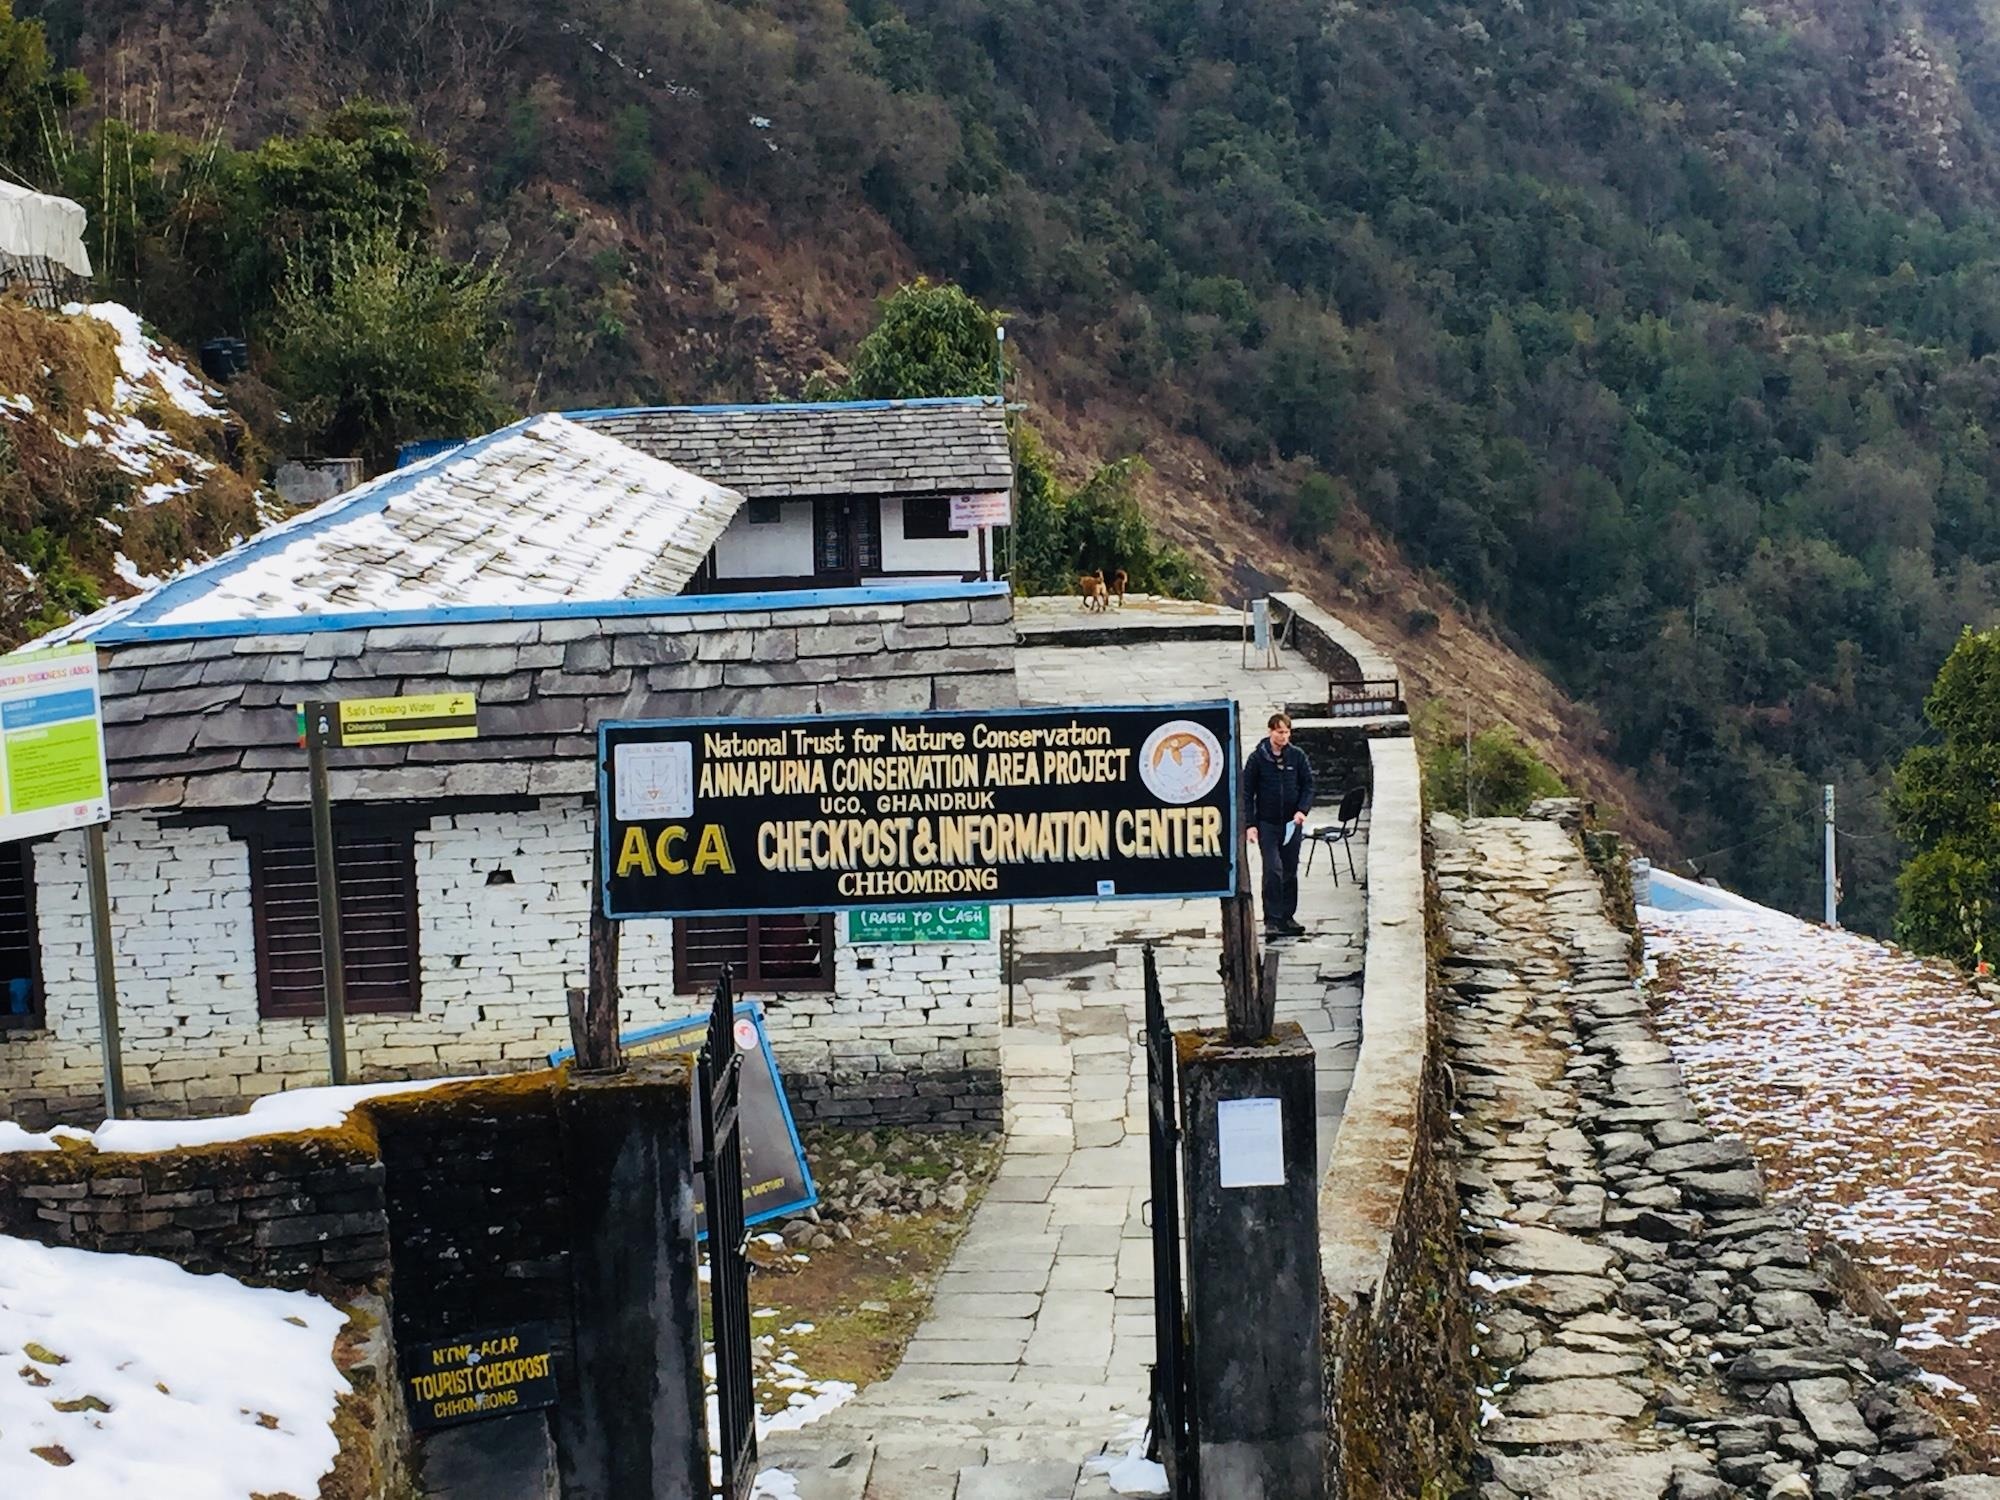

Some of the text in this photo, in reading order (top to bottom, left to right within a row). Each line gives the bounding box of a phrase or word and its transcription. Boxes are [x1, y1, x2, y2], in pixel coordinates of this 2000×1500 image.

[345, 702, 435, 718] Safe Drinking Water
[703, 720, 1112, 758] National Trust for Nature Conservation
[698, 758, 828, 798] ANNAPURNA
[832, 752, 979, 793] CONSERVATION
[984, 751, 1041, 787] AREA
[1044, 748, 1131, 785] PROJECT
[877, 791, 995, 813] GHANDRUK
[616, 824, 736, 877] ACA
[1115, 806, 1223, 859] CENTER
[838, 868, 998, 896] CHHOMRONG
[939, 905, 982, 924] CASH
[411, 1353, 552, 1401] TOURIST CHECKPOST
